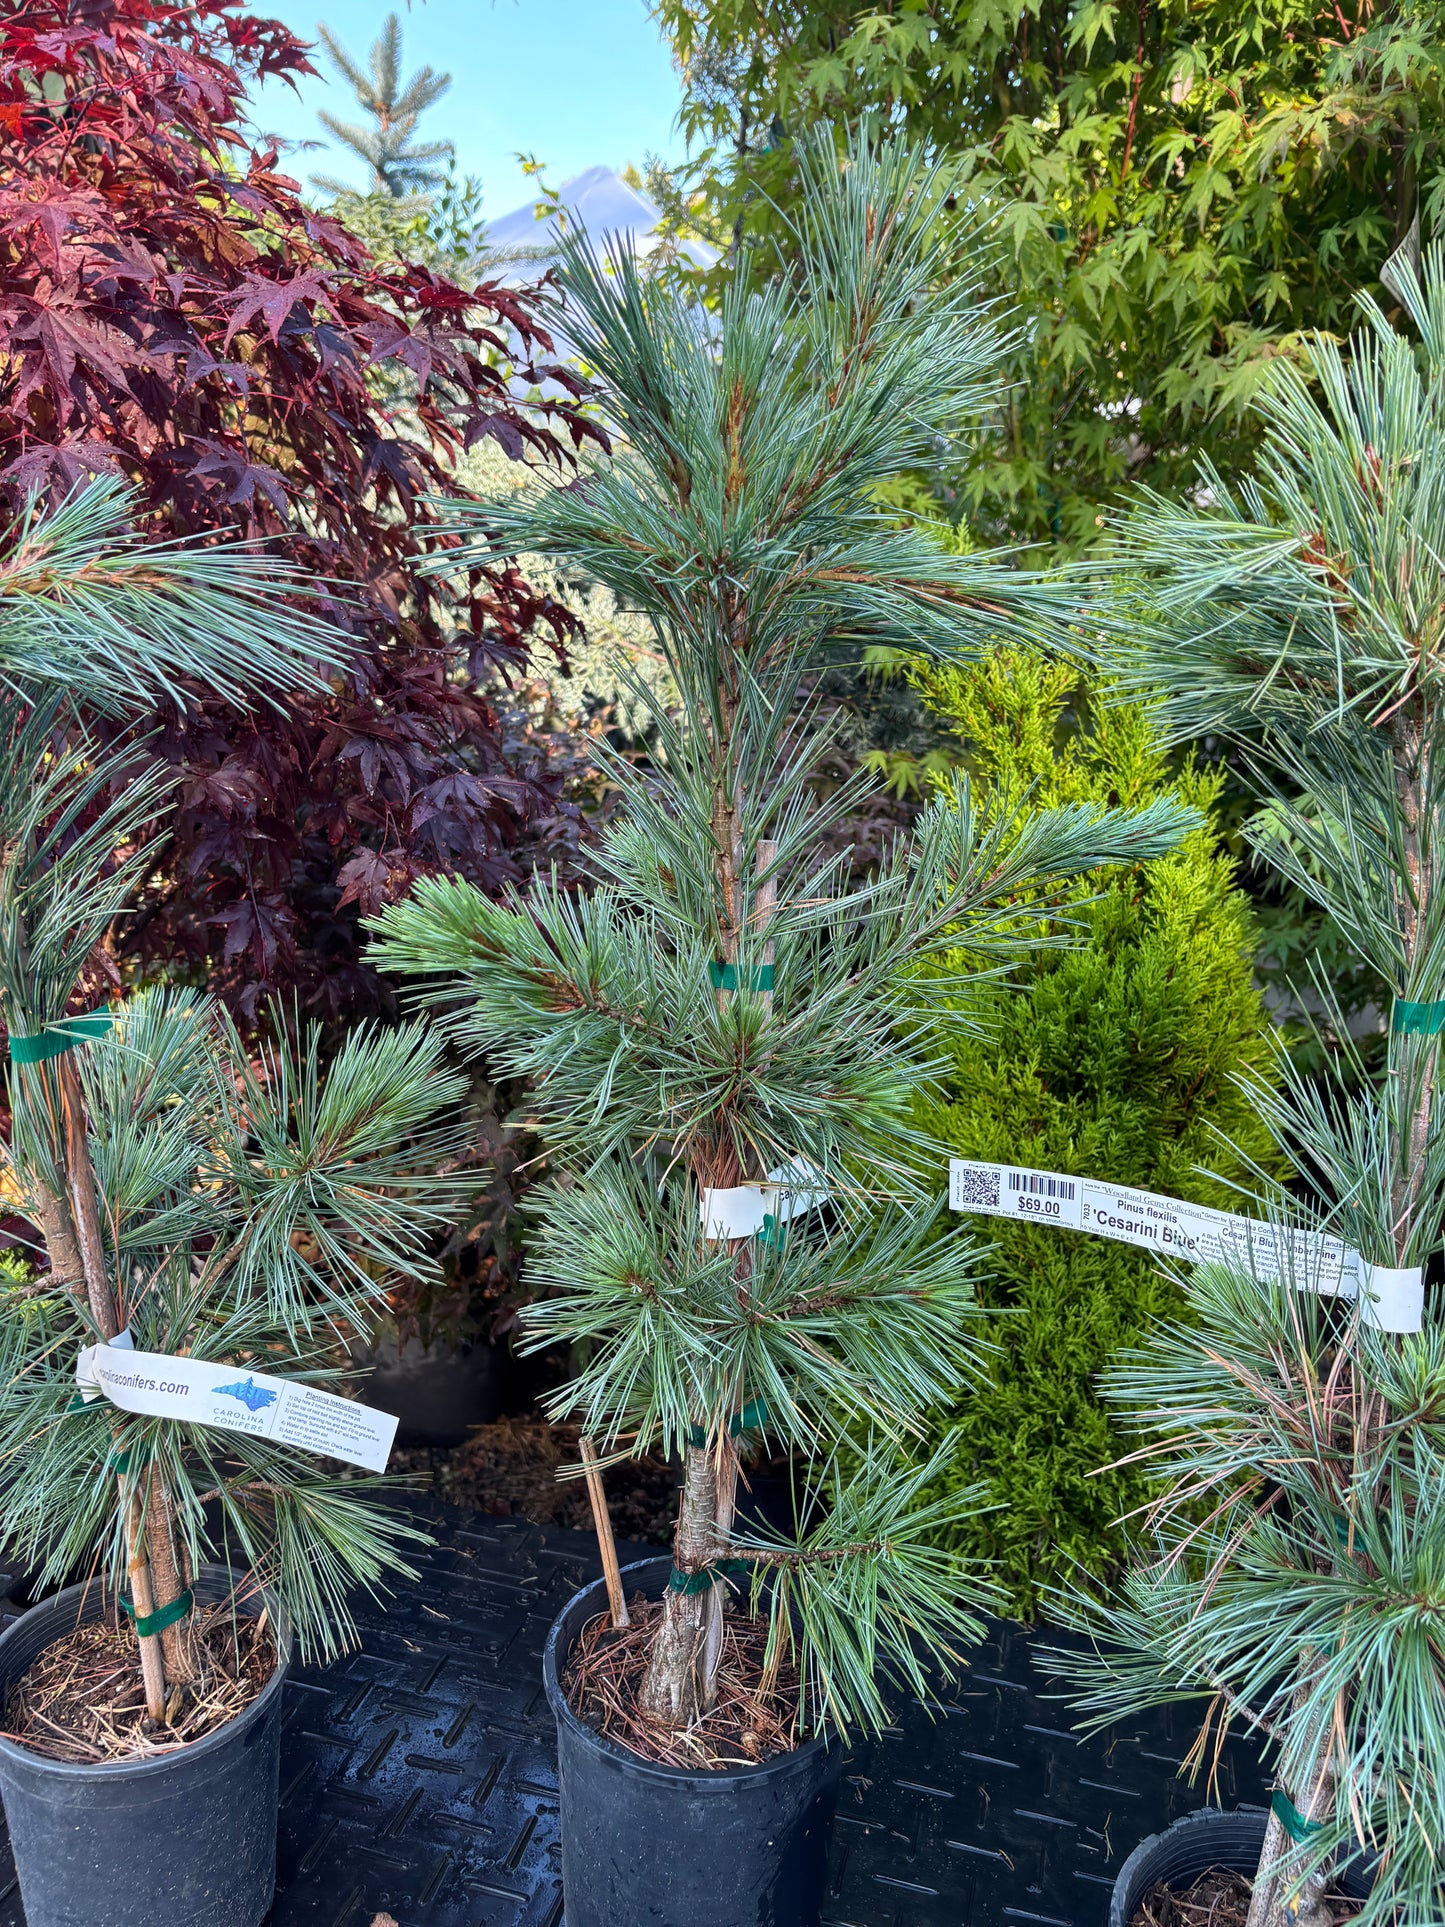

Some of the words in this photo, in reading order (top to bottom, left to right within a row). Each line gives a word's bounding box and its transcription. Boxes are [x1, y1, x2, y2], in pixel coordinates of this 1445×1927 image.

[1018, 1196, 1060, 1215] $69.00
[1144, 1196, 1165, 1207] Gems
[1083, 1203, 1091, 1220] 7033
[1117, 1199, 1144, 1215] Pinus
[1147, 1207, 1178, 1224] flexilis
[1093, 1208, 1158, 1239] 'Cesarini
[305, 1392, 329, 1403] Planting
[329, 1399, 361, 1413] Instructions
[213, 1408, 264, 1424] CAROLINA
[213, 1416, 264, 1433] CONIFERS
